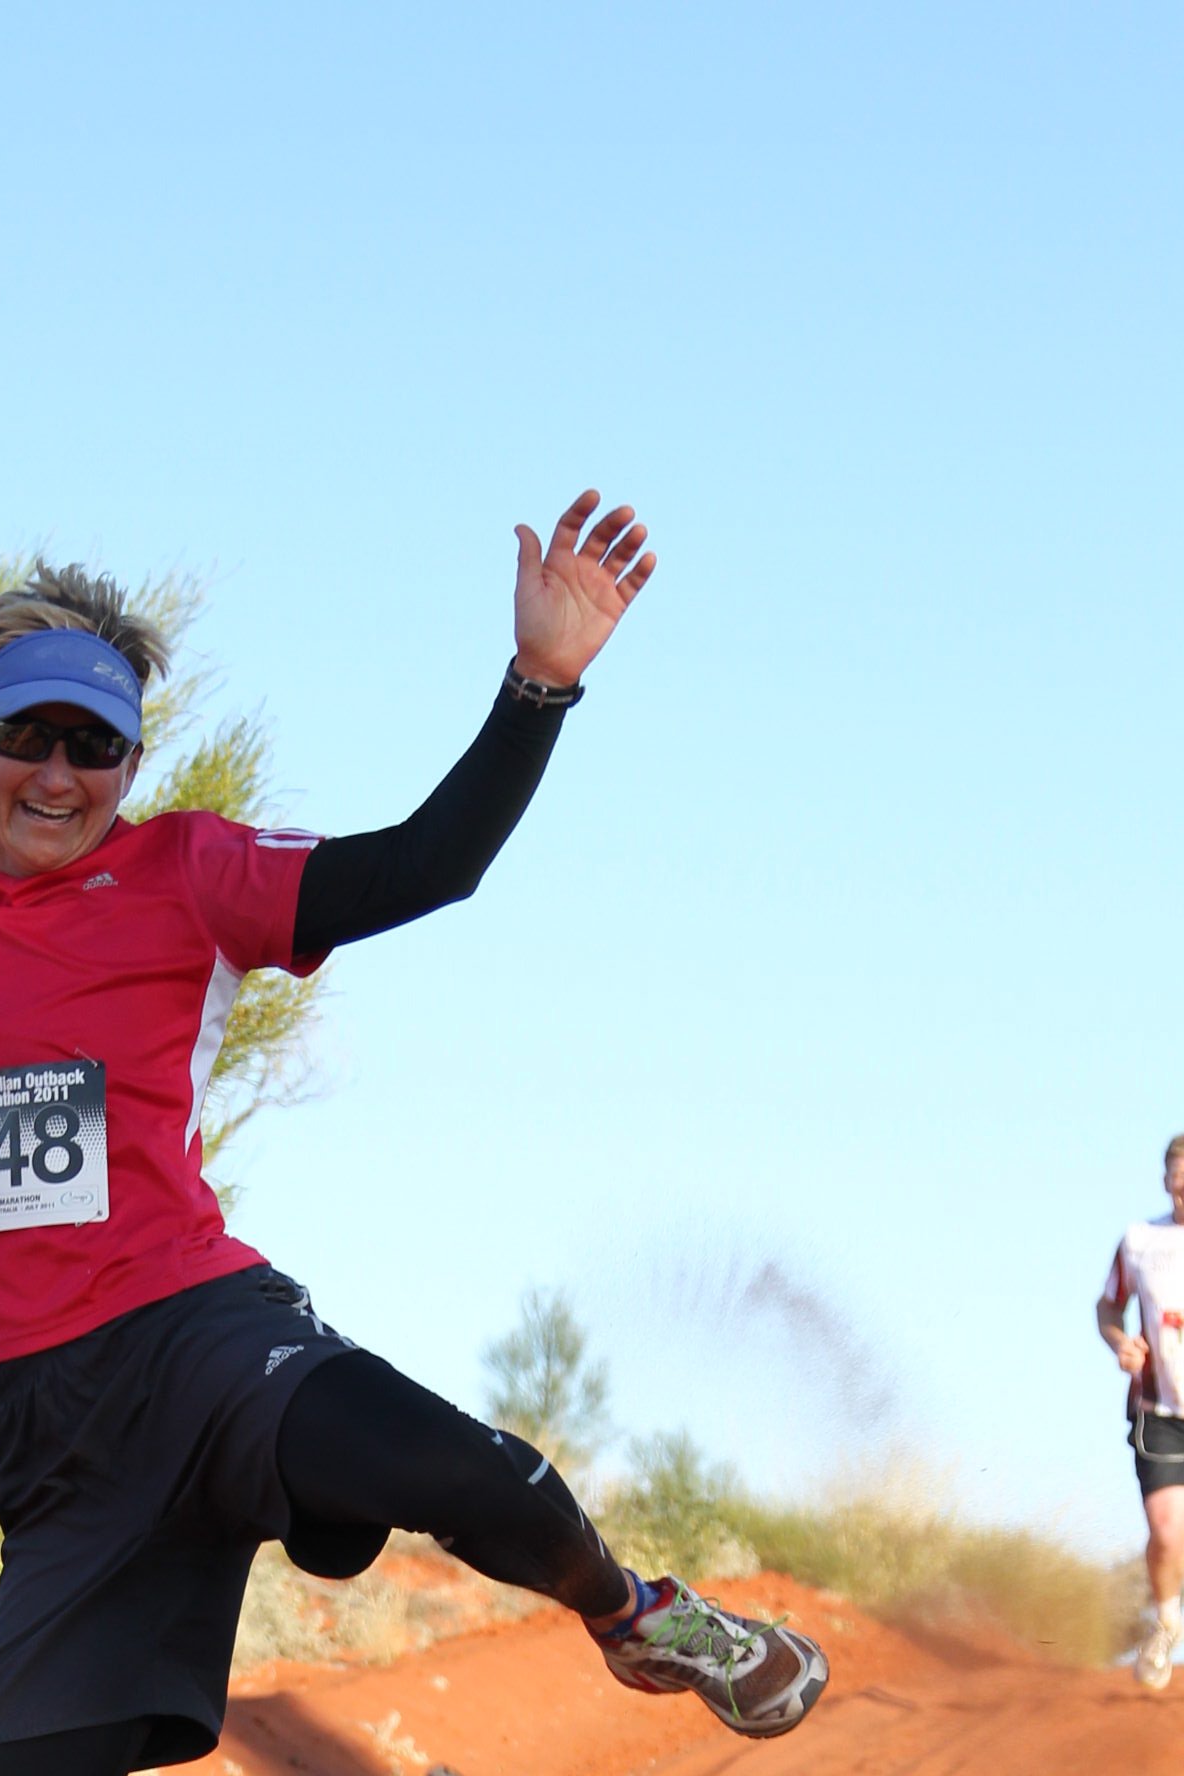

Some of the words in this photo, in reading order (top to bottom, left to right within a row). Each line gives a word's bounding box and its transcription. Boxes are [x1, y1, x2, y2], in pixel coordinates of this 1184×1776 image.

[82, 879, 118, 891] adidas
[25, 1068, 85, 1089] Outback
[33, 1085, 69, 1103] 2011
[0, 1194, 41, 1206] MARATHON
[265, 1345, 304, 1375] adidas
